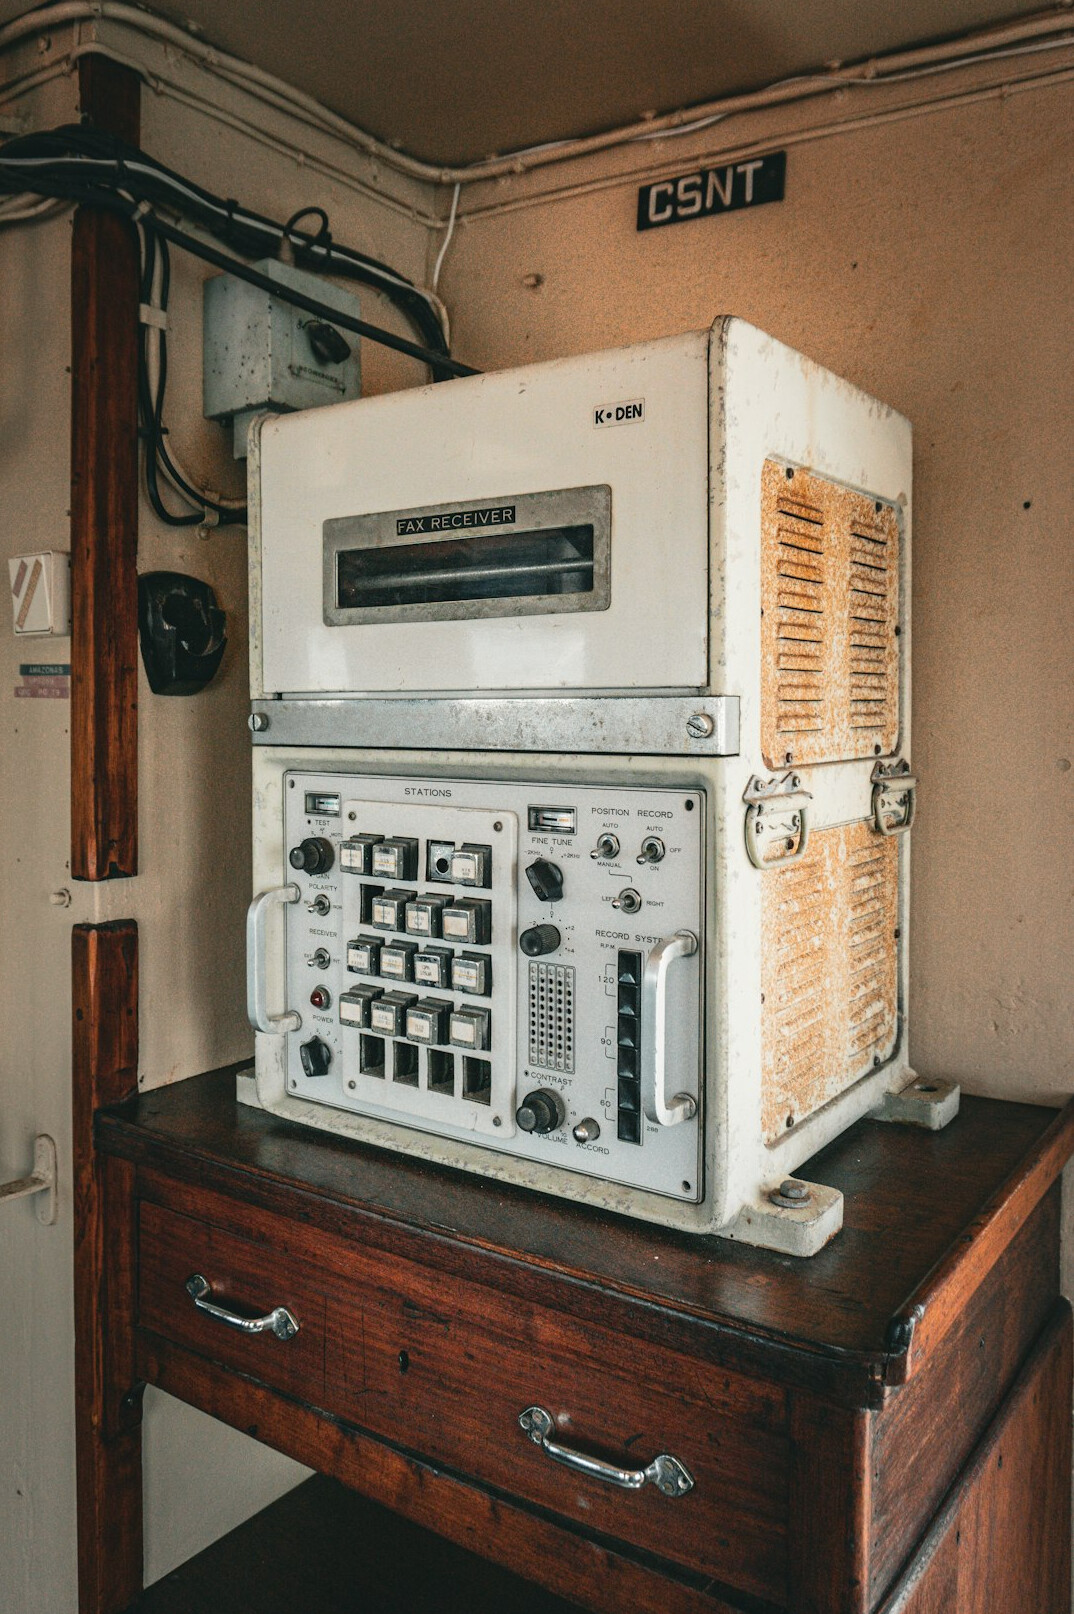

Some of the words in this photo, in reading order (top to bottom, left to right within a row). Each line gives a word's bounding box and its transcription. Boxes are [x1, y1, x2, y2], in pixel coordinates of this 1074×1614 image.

[648, 160, 764, 222] CSNT
[398, 519, 425, 533] FAX
[431, 509, 513, 530] RECEIVER
[404, 787, 452, 797] STATIONS
[591, 807, 630, 816] POSITION
[637, 810, 673, 819] RECORD
[531, 837, 549, 845] FINE
[552, 838, 573, 846] TUNE
[308, 883, 338, 892] POLARITY
[309, 928, 338, 938] RECEIVER
[595, 929, 630, 940] RECORD
[634, 934, 664, 944] SYST
[598, 975, 615, 984] 120
[312, 1014, 334, 1024] POWER
[600, 1038, 612, 1046] 90
[530, 1071, 573, 1086] CONTRAST
[600, 1099, 611, 1108] 60
[537, 1133, 568, 1145] VOLUME
[575, 1142, 610, 1155] ACCORD
